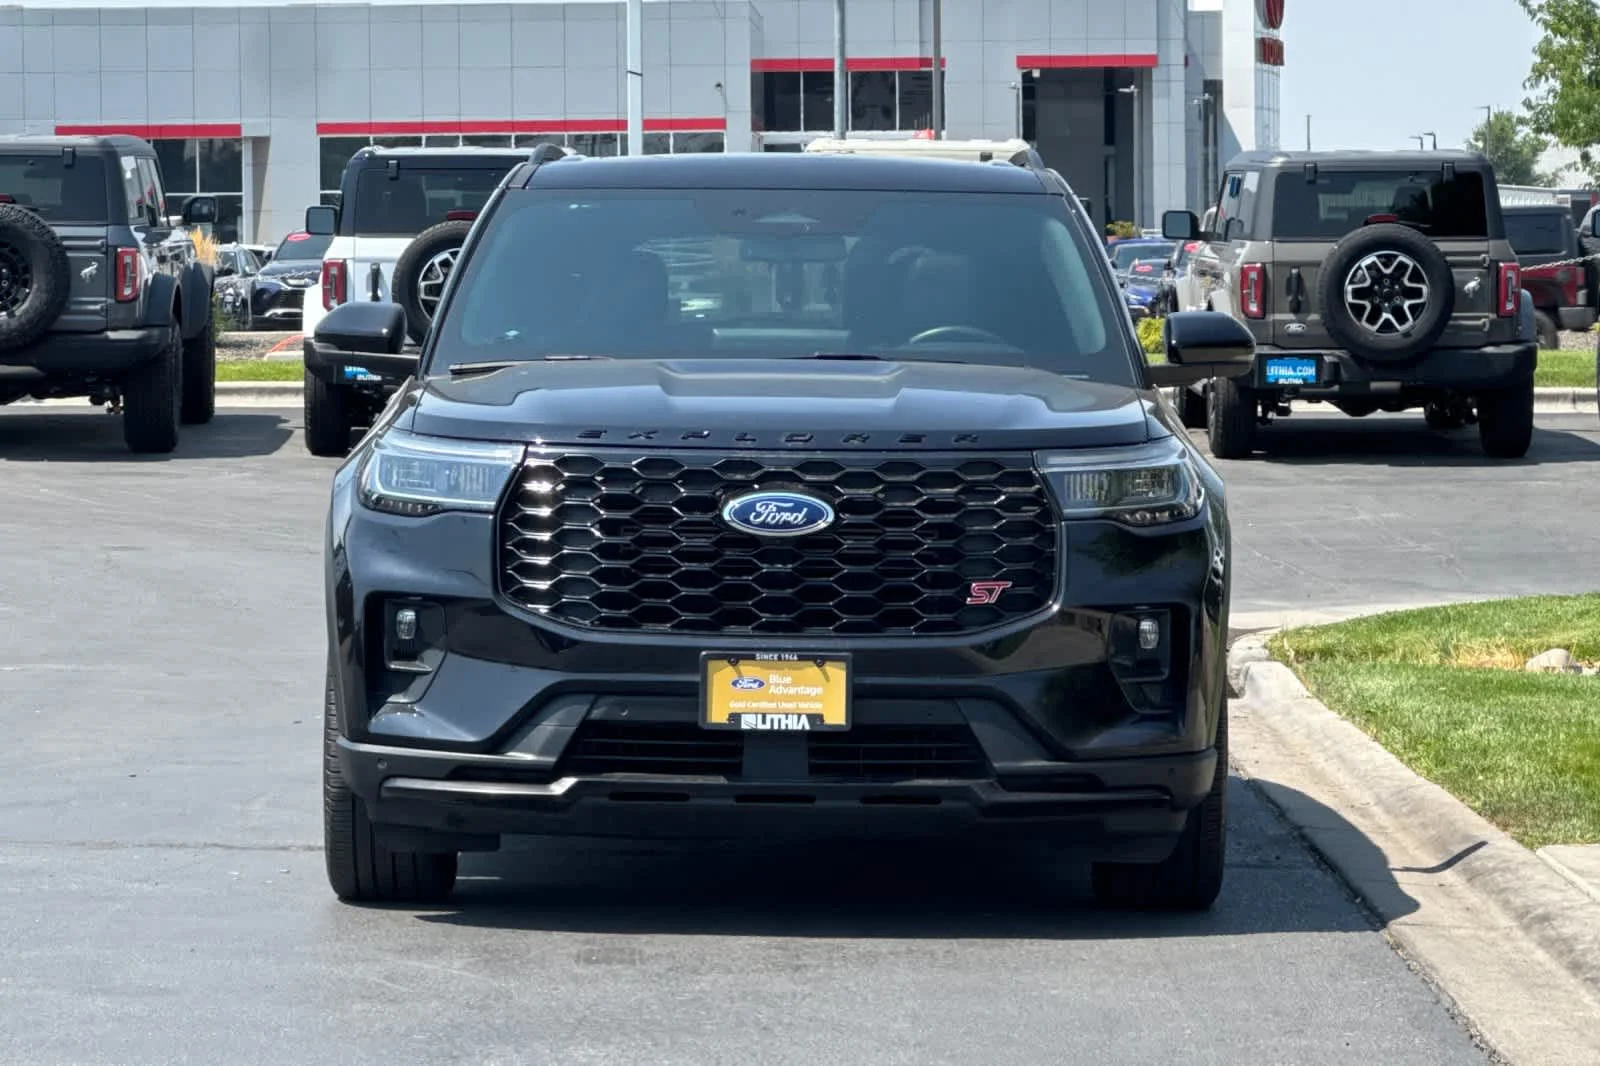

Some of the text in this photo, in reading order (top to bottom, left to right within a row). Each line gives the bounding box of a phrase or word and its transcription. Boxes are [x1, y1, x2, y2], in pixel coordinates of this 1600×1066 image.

[1266, 365, 1316, 376] LITHIA.COM
[576, 429, 981, 444] EXPLORER
[749, 501, 808, 525] Ford
[966, 581, 1013, 605] ST
[755, 653, 778, 661] SINCE
[736, 678, 760, 689] Ford
[769, 674, 792, 684] Blue
[768, 686, 823, 697] Advantage
[757, 714, 810, 730] LITHIA
